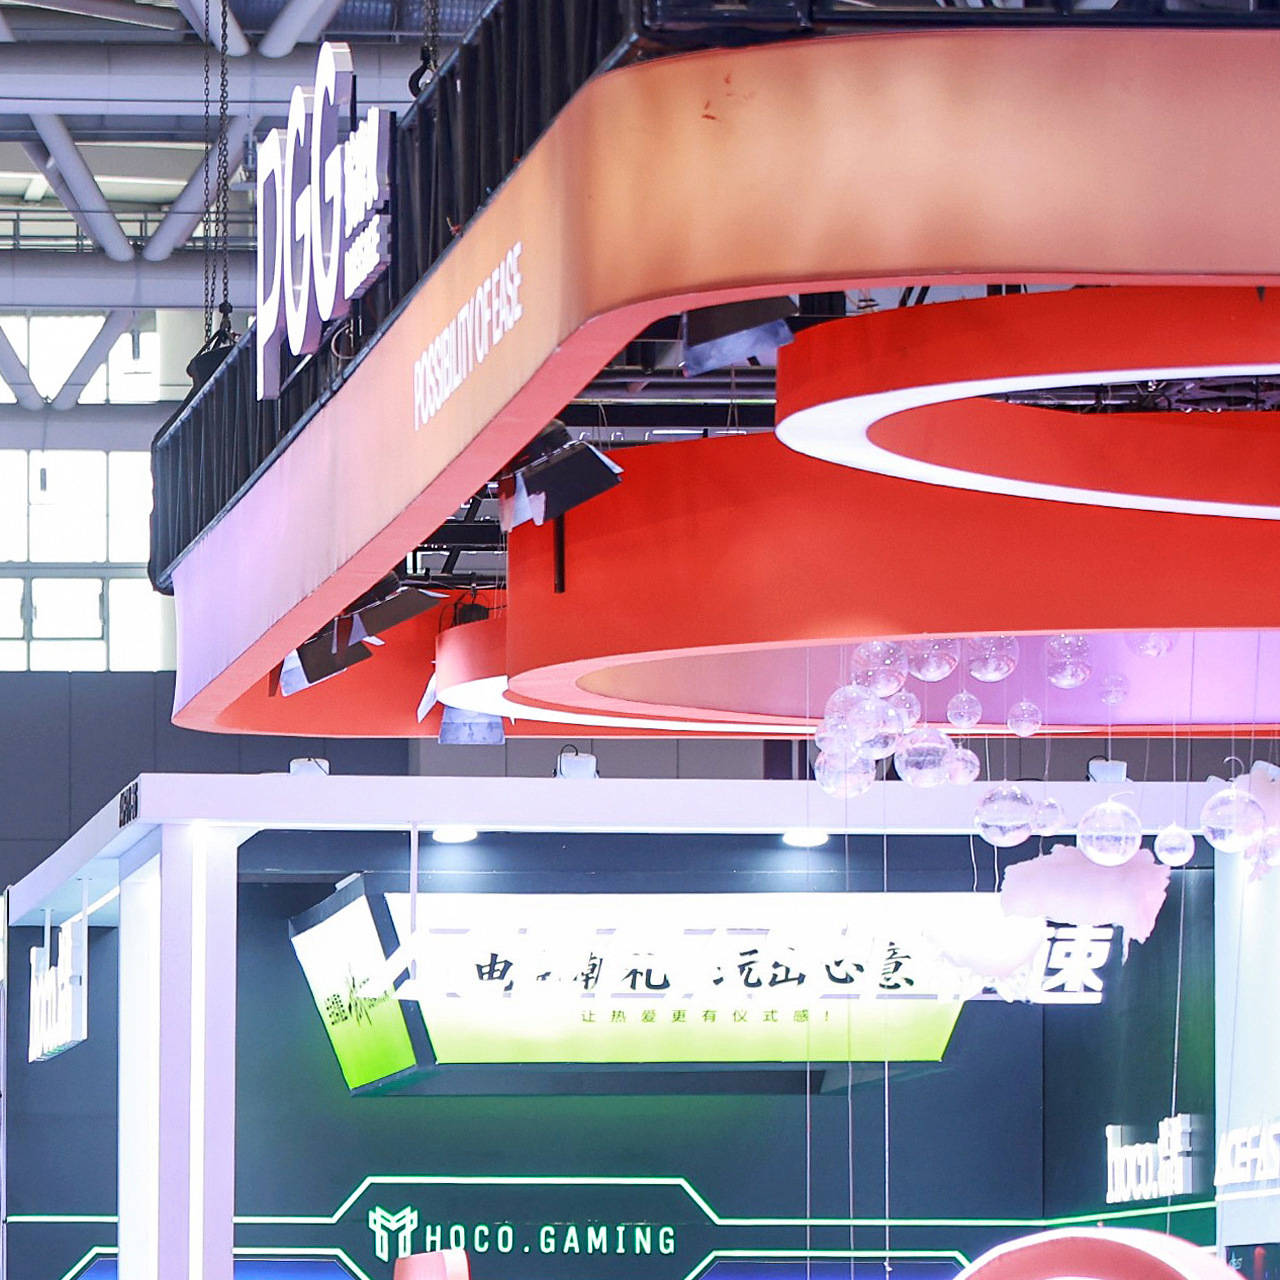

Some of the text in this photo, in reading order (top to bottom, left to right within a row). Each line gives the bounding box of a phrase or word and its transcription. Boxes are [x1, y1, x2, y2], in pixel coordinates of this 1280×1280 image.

[413, 241, 523, 431] POSSIBILITY OF EASE
[425, 1224, 676, 1254] HOCO.GAMING
